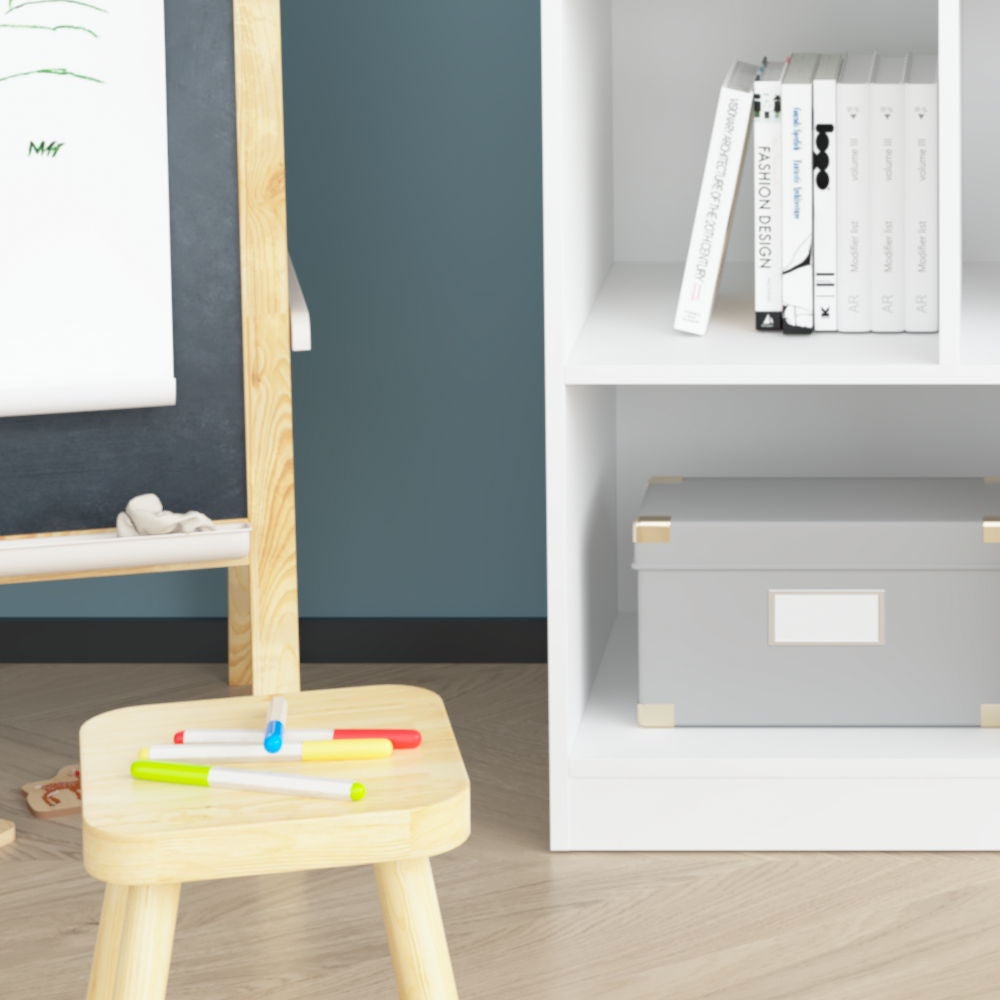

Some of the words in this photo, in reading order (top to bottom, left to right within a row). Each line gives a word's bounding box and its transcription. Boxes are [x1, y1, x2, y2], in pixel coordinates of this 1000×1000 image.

[758, 146, 771, 210] FASHION
[849, 149, 859, 181] volume
[883, 149, 893, 181] volume
[917, 149, 927, 181] volume
[759, 215, 771, 269] DESIGN
[849, 220, 859, 234] list
[883, 220, 893, 234] list
[917, 220, 927, 234] list
[849, 236, 859, 272] Modifier
[883, 236, 893, 272] Modifier
[917, 236, 927, 272] Modifier
[848, 294, 859, 314] AR
[882, 294, 894, 314] AR
[916, 294, 927, 314] AR
